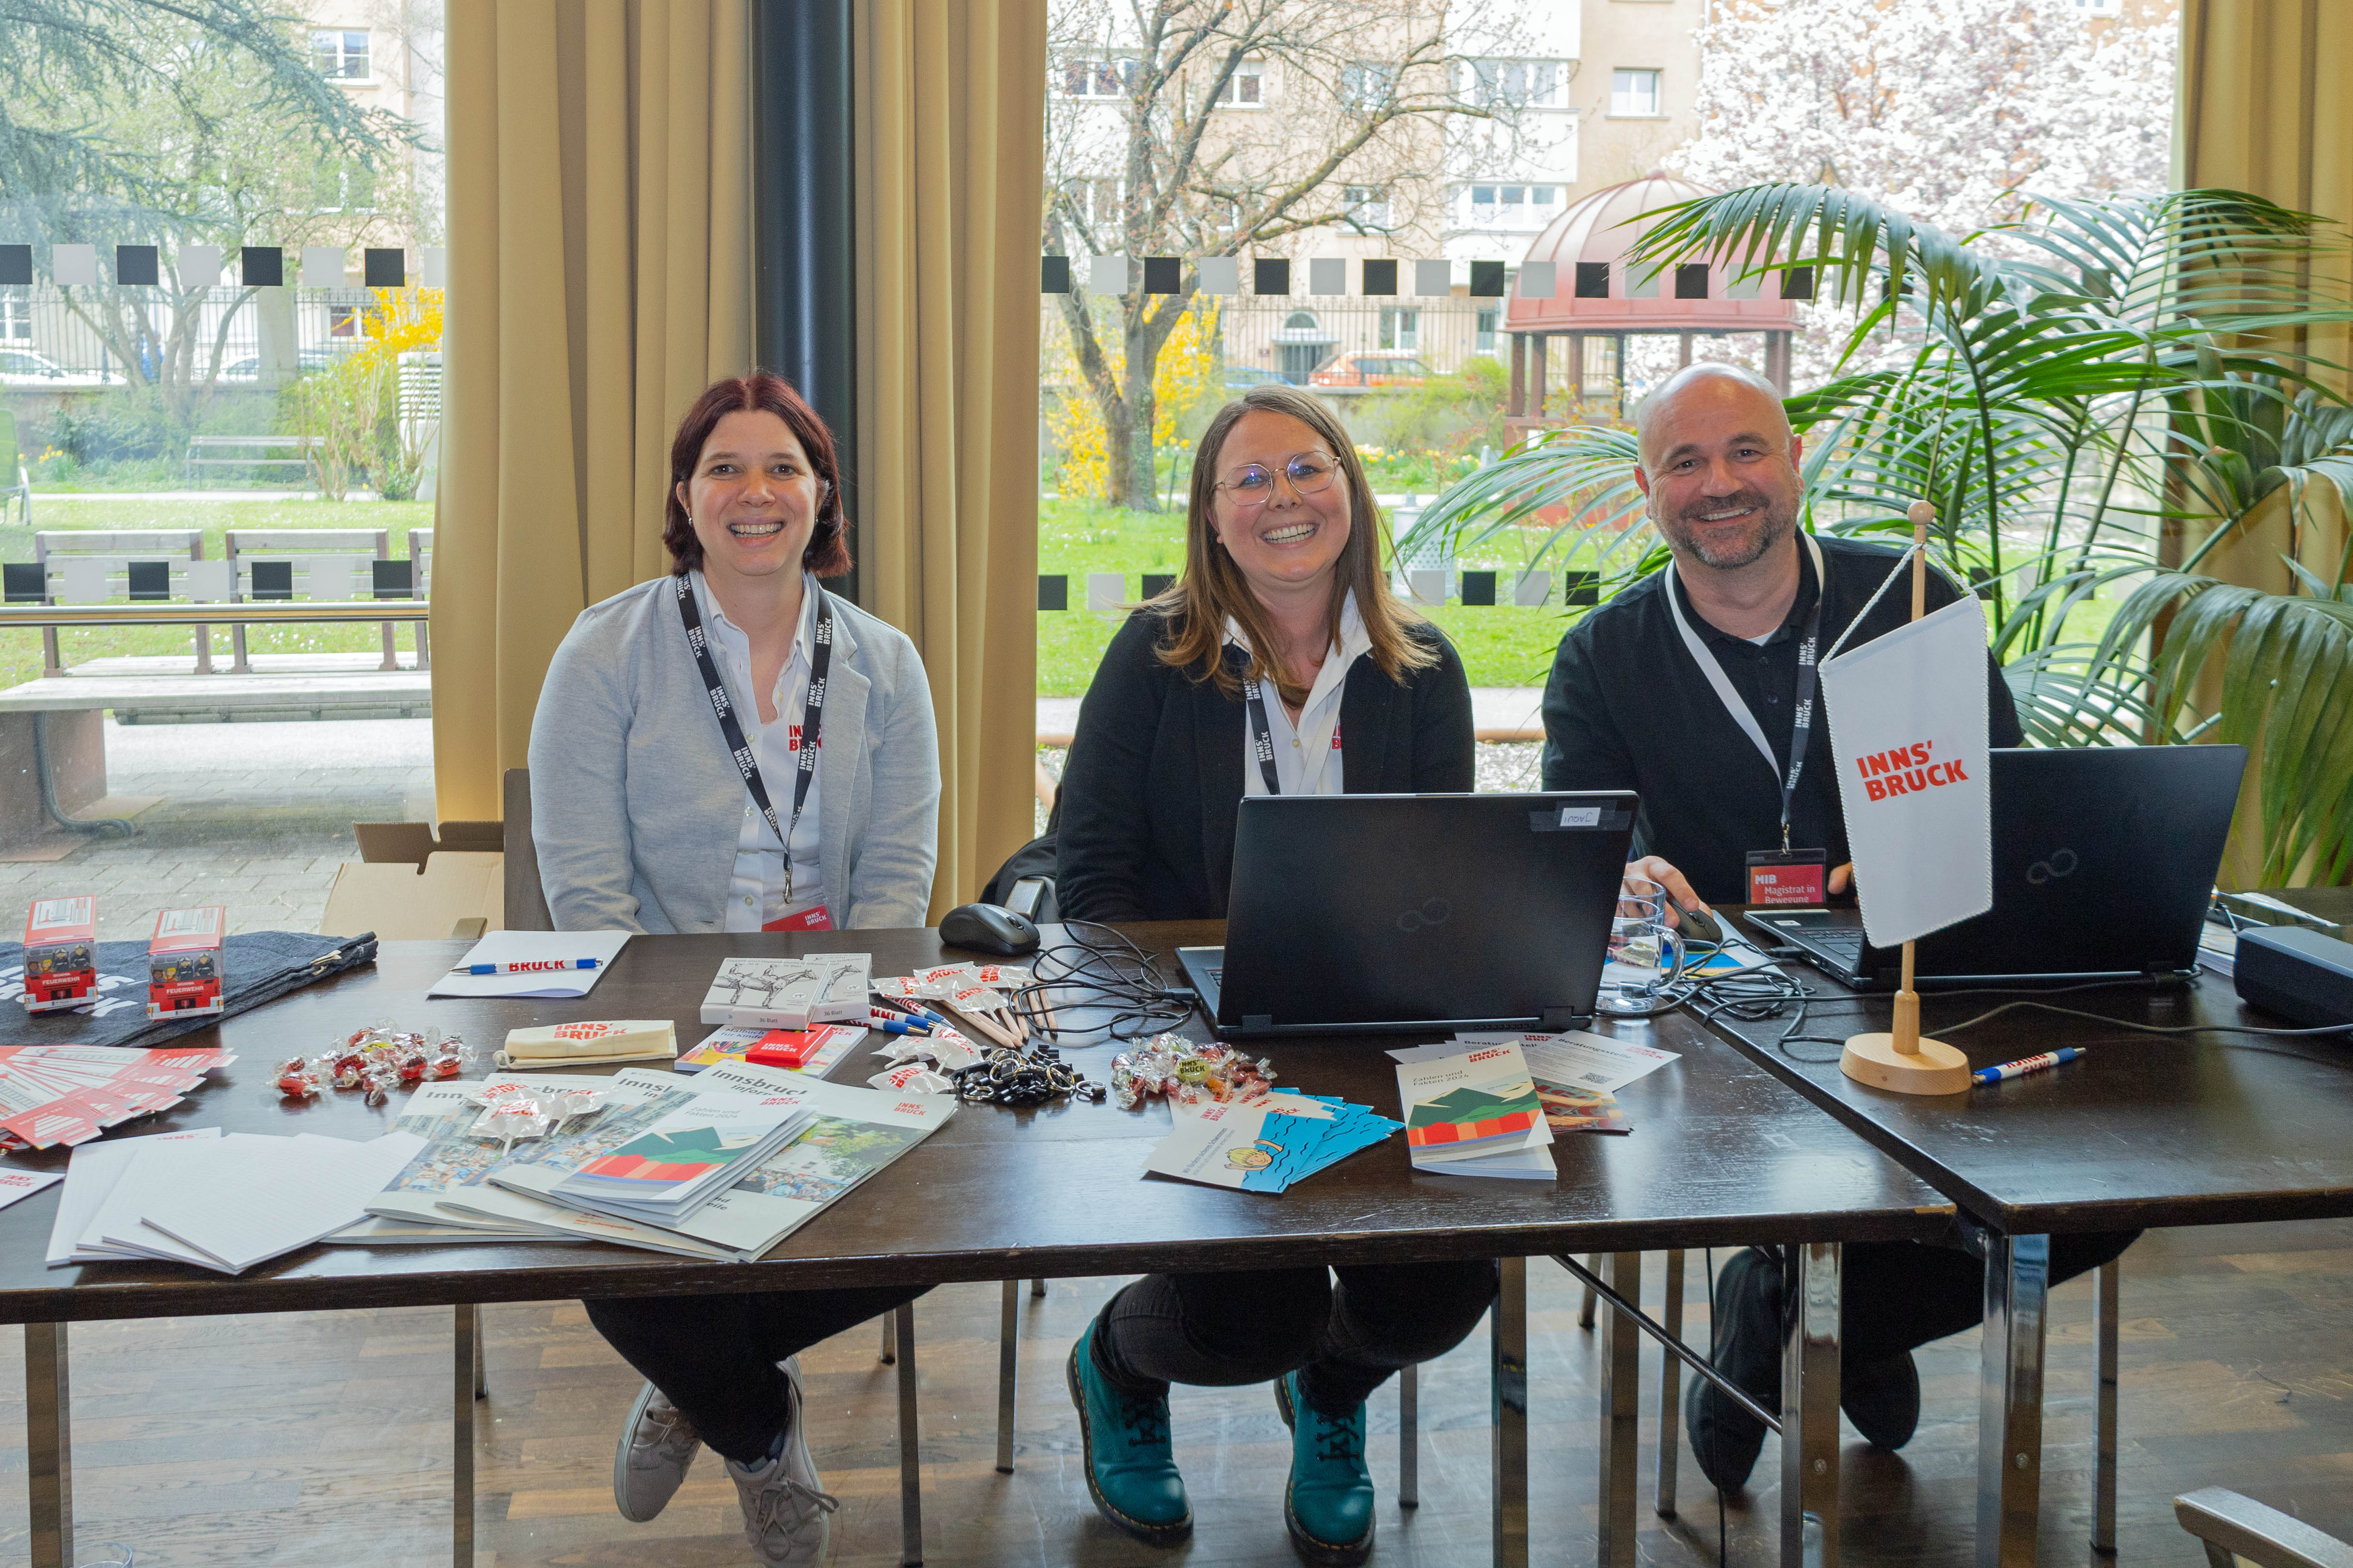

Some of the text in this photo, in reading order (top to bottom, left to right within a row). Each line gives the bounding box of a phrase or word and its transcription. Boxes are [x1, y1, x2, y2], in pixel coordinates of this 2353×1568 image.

[695, 626, 705, 648] INNS'
[823, 618, 832, 645] BRUCK
[688, 629, 703, 658] BRUCK
[1798, 643, 1807, 665] INNS'
[1806, 637, 1816, 666] BRUCK
[716, 685, 730, 709] INNS'
[807, 682, 816, 706] INNS'
[814, 677, 825, 707] BRUCK
[710, 689, 726, 719] BRUCK
[1802, 699, 1811, 728] BRUCK
[1795, 704, 1803, 727] INNS'
[806, 741, 816, 771] BRUCK
[1255, 739, 1267, 762] INNS'
[1262, 731, 1273, 761] BRUCK
[733, 750, 752, 779] BRUCK
[741, 746, 756, 769] INNS'
[799, 746, 808, 770] INNS'
[1856, 740, 1932, 778] INNS'
[1864, 759, 1970, 802] BRUCK
[1564, 812, 1593, 822] JAQUI
[1755, 874, 1777, 884] MIB
[1765, 884, 1815, 896] Magistrat in
[1765, 896, 1809, 904] Bewegung
[805, 911, 821, 921] INNS'
[806, 914, 827, 926] BRUCK
[509, 960, 565, 972] BRUCK
[42, 976, 80, 985] FEUERWEHR
[166, 986, 204, 994] FEUERWEHR
[554, 1028, 627, 1040] BRUCK
[1468, 1048, 1500, 1059] INNS'
[1470, 1050, 1511, 1063] BRUCK
[1558, 1038, 1632, 1059] Beratungsstelle
[1626, 1049, 1665, 1059] BRUCK
[1180, 1065, 1205, 1074] BRUCK
[1413, 1074, 1443, 1082] Zahlen
[893, 1107, 926, 1116] BRUCK
[1209, 1107, 1229, 1121] BRUCK
